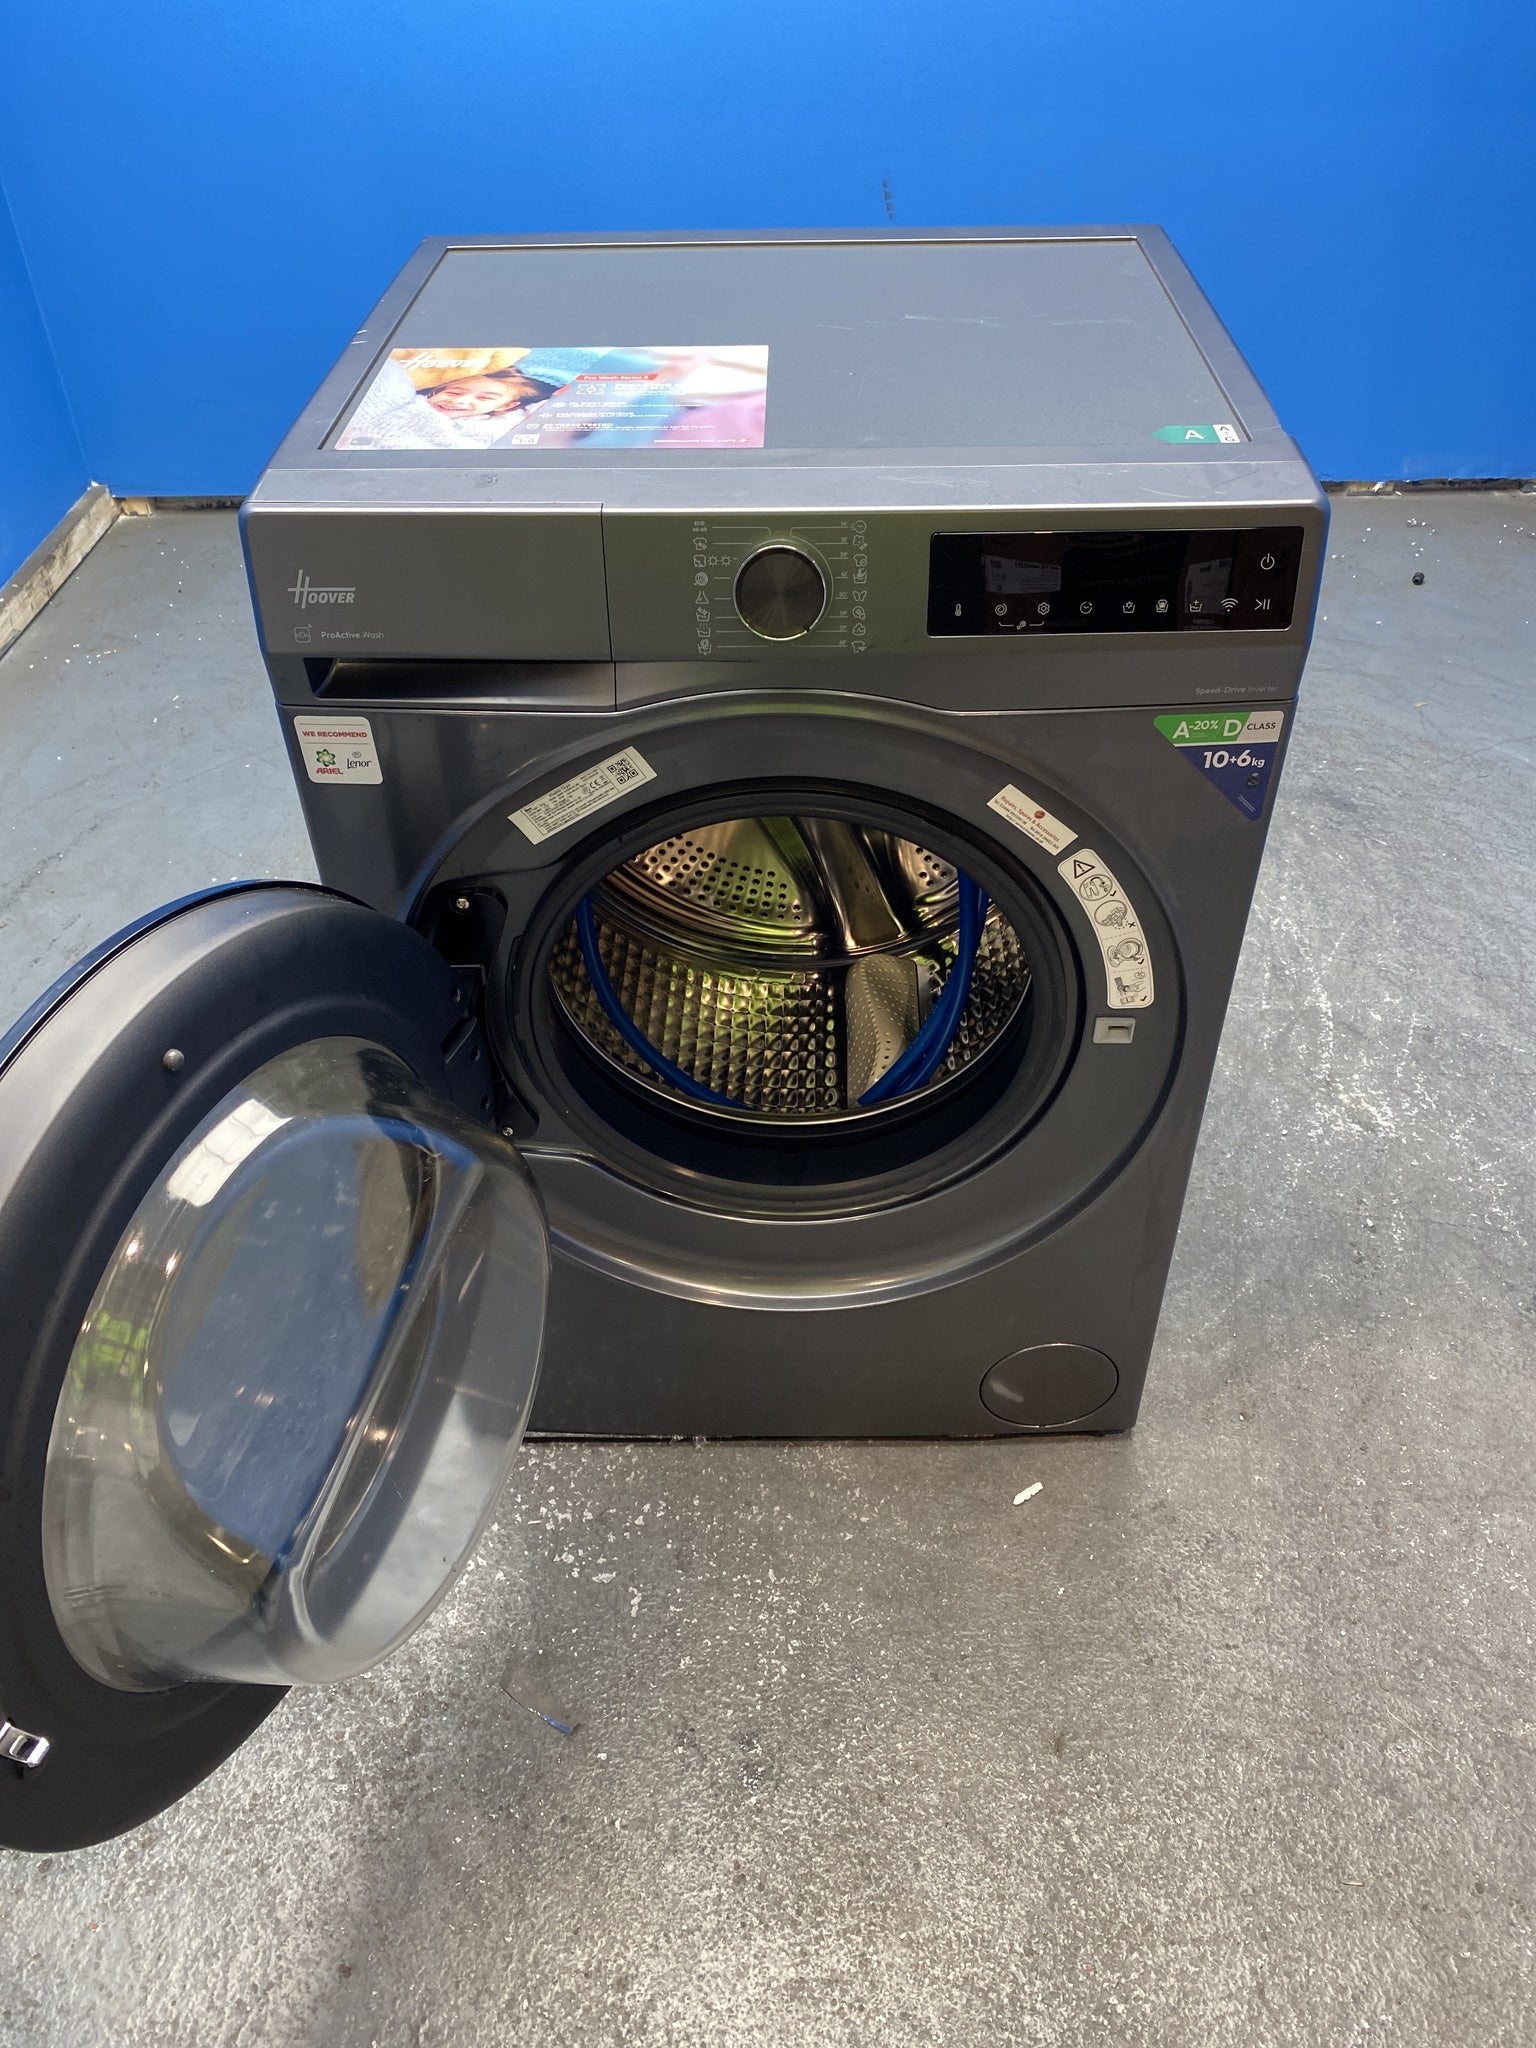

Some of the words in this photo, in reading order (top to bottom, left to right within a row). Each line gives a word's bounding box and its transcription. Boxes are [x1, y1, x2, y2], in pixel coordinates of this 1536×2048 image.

[1184, 429, 1205, 440] A
[288, 569, 356, 609] HOOVER
[321, 630, 360, 640] ProActive
[362, 631, 384, 639] Wash
[1195, 687, 1247, 695] Speed-Drive
[1223, 719, 1242, 737] D
[1246, 722, 1277, 731] CLASS
[302, 730, 316, 738] WE
[316, 730, 368, 738] RECOMMEND
[346, 757, 372, 769] Lenor
[316, 767, 344, 775] ARIEL
[1018, 808, 1034, 821] Spares
[1035, 823, 1060, 842] Accessories
